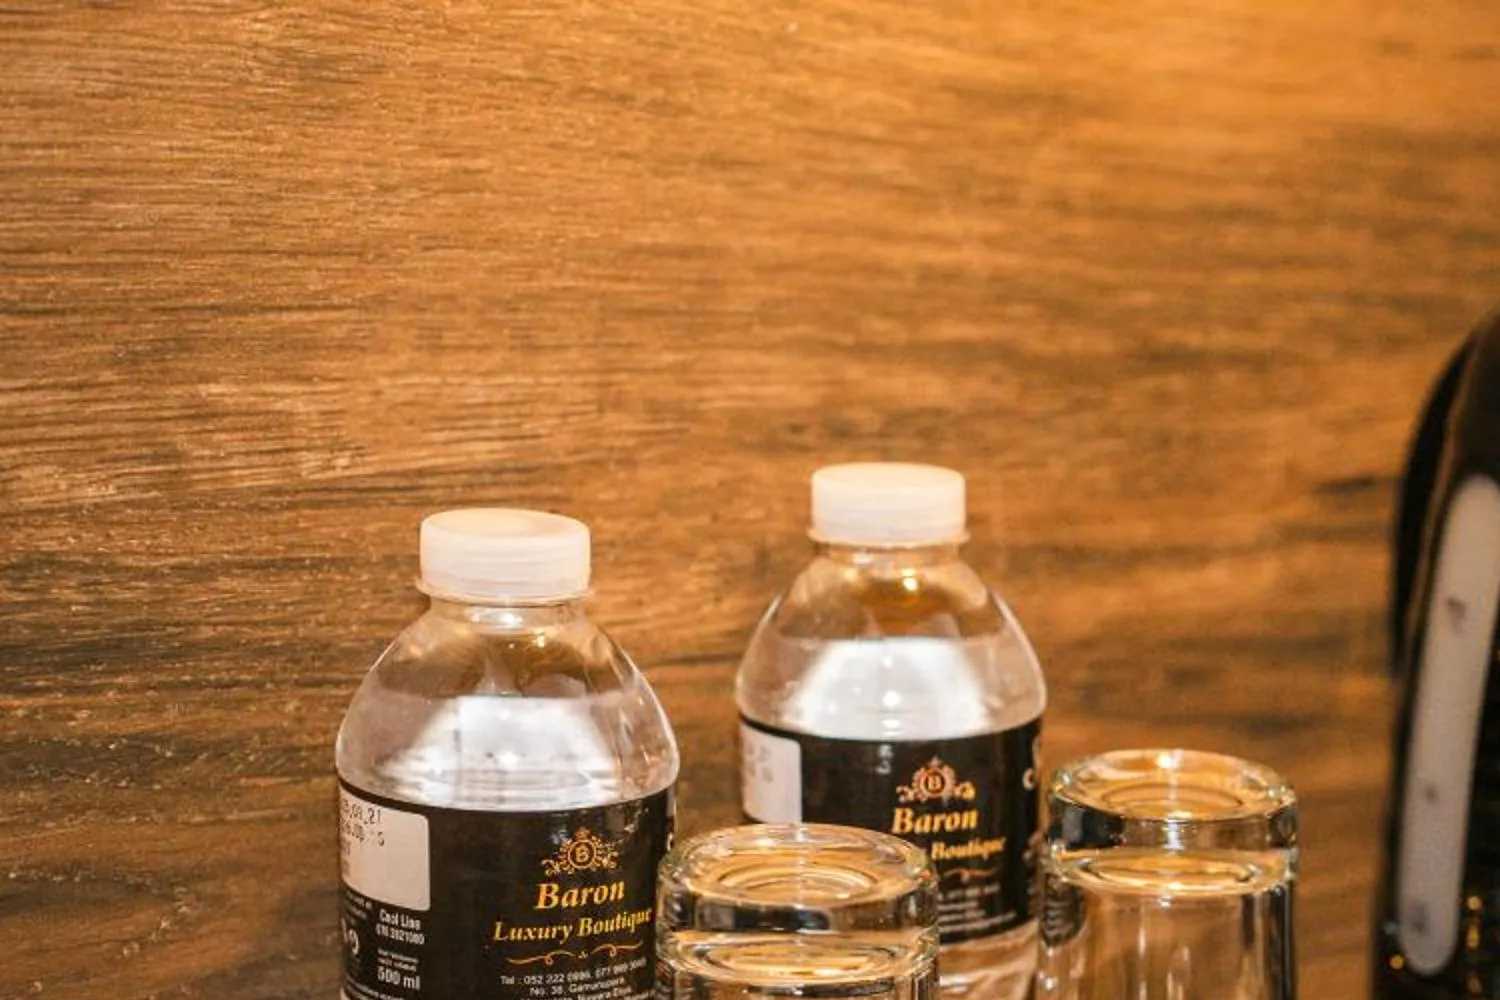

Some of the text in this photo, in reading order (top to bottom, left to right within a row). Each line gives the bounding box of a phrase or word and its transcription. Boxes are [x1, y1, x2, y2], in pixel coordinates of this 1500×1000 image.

[891, 807, 980, 834] Baron
[532, 880, 625, 909] Baron
[493, 908, 652, 945] Luxury Boutique
[377, 965, 421, 991] 500 ml
